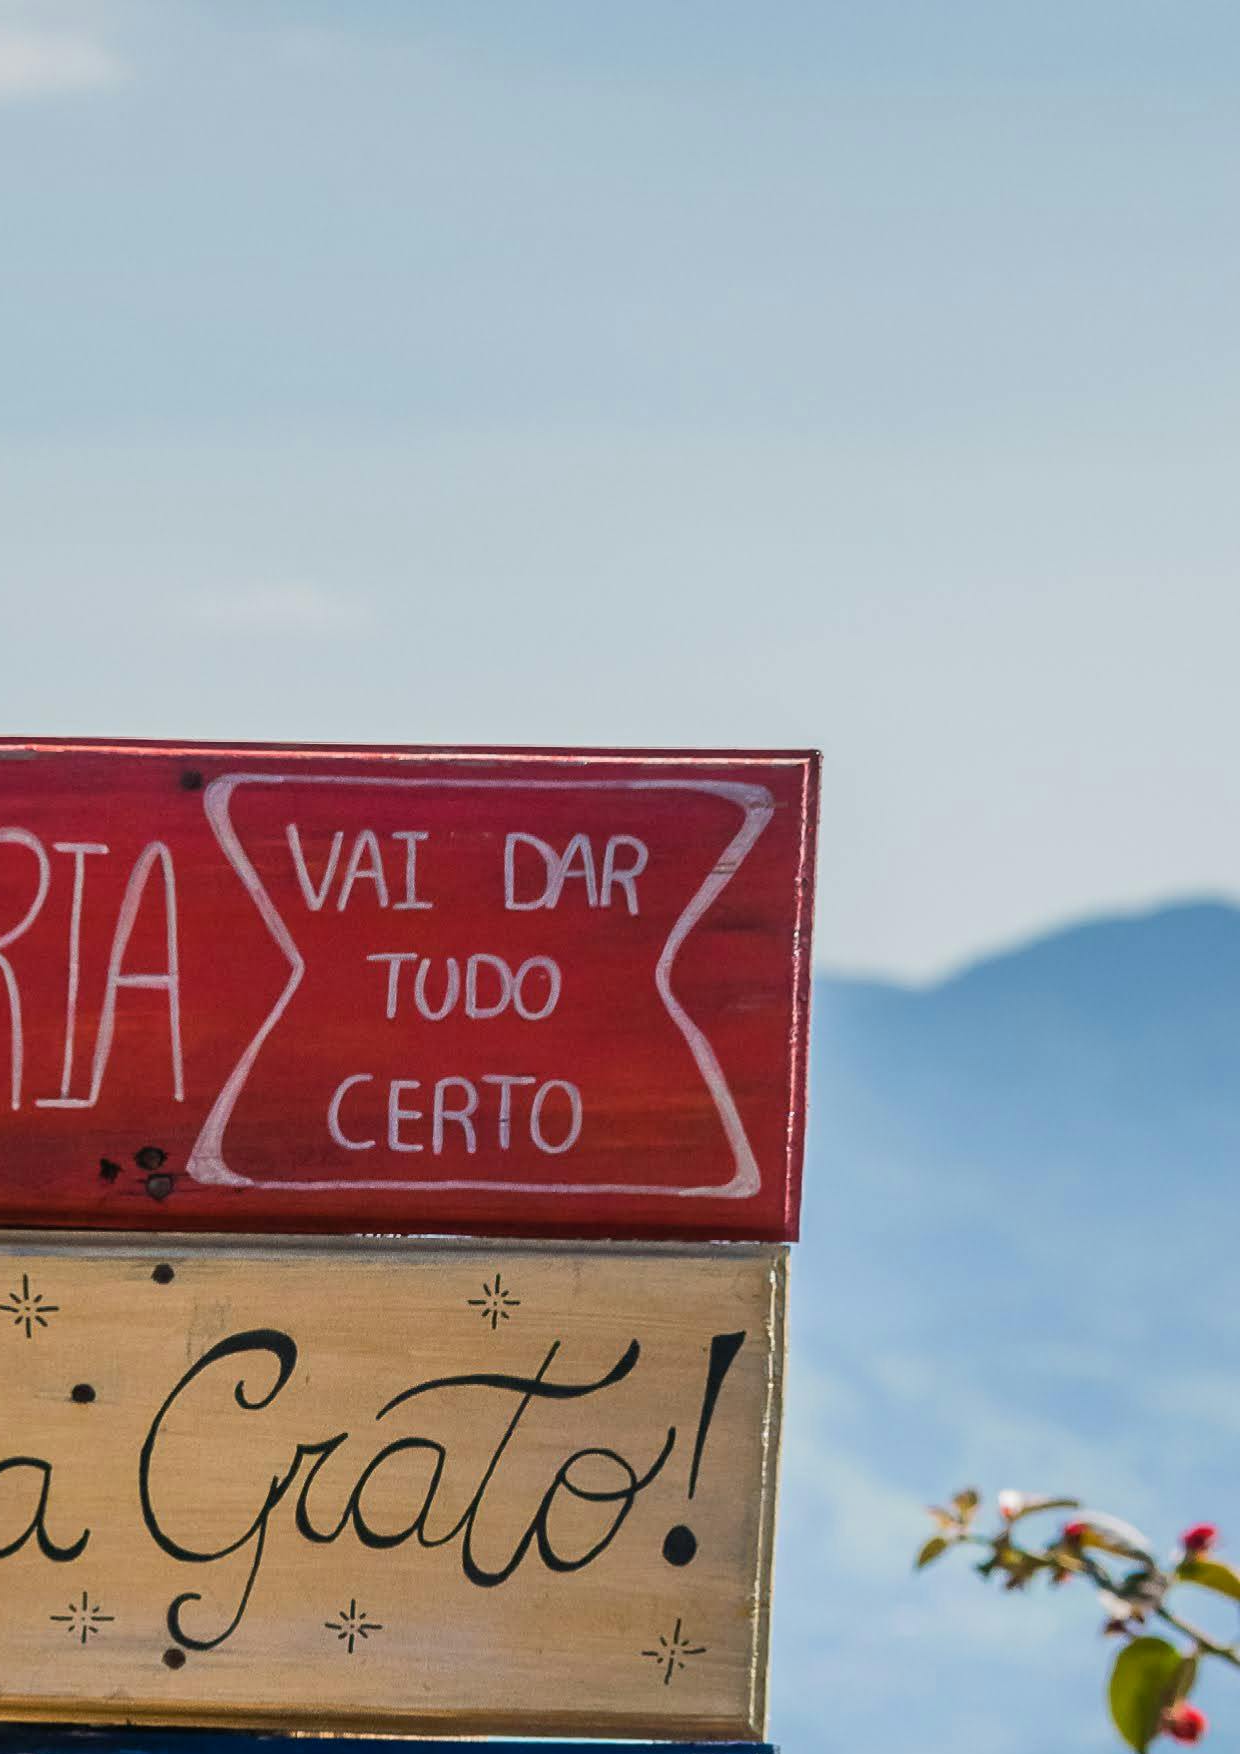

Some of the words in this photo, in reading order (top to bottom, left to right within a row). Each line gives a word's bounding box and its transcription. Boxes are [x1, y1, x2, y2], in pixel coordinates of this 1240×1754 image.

[287, 822, 434, 912] VAI
[504, 831, 649, 916] DAR
[367, 952, 562, 1021] TUDO
[327, 1073, 584, 1155] CERTO
[138, 1328, 748, 1652] Grato!
